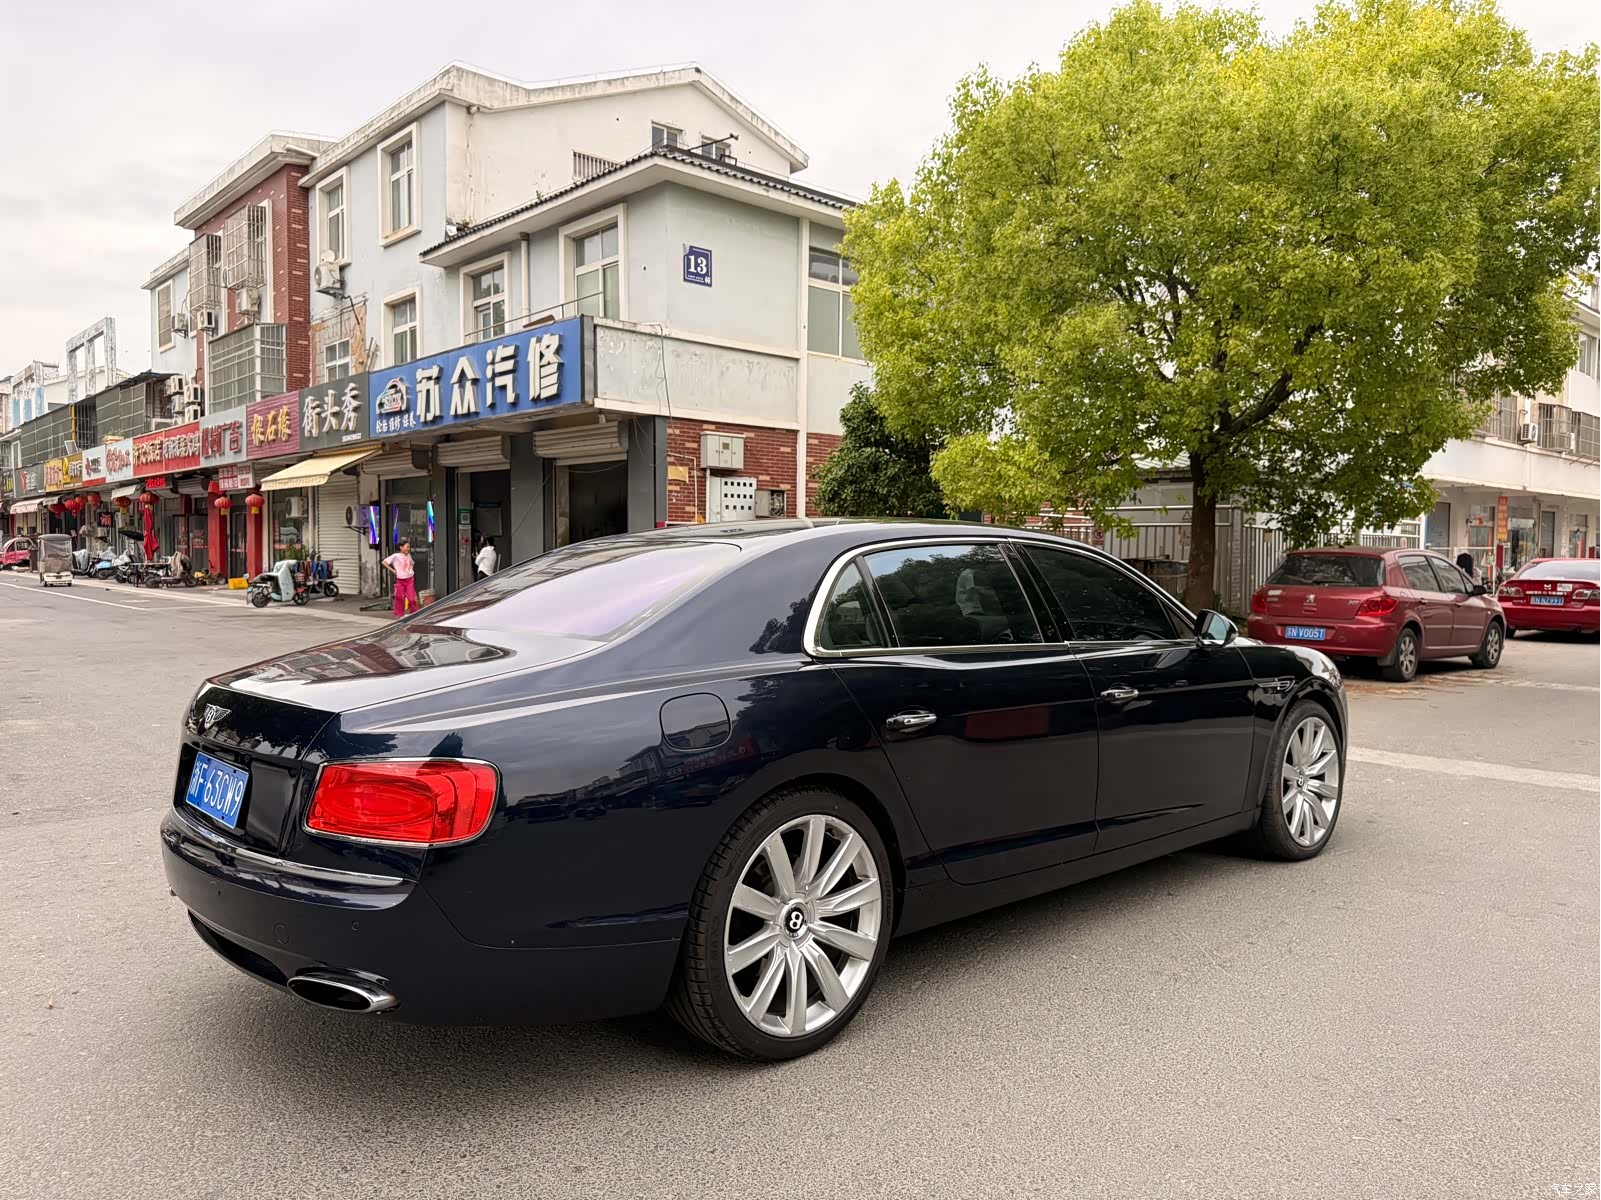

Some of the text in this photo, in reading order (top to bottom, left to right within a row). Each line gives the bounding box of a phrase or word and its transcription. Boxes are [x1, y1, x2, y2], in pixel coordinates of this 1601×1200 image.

[688, 255, 707, 274] 13
[416, 333, 564, 422] 苏众汽修
[302, 383, 362, 437] 街头秀
